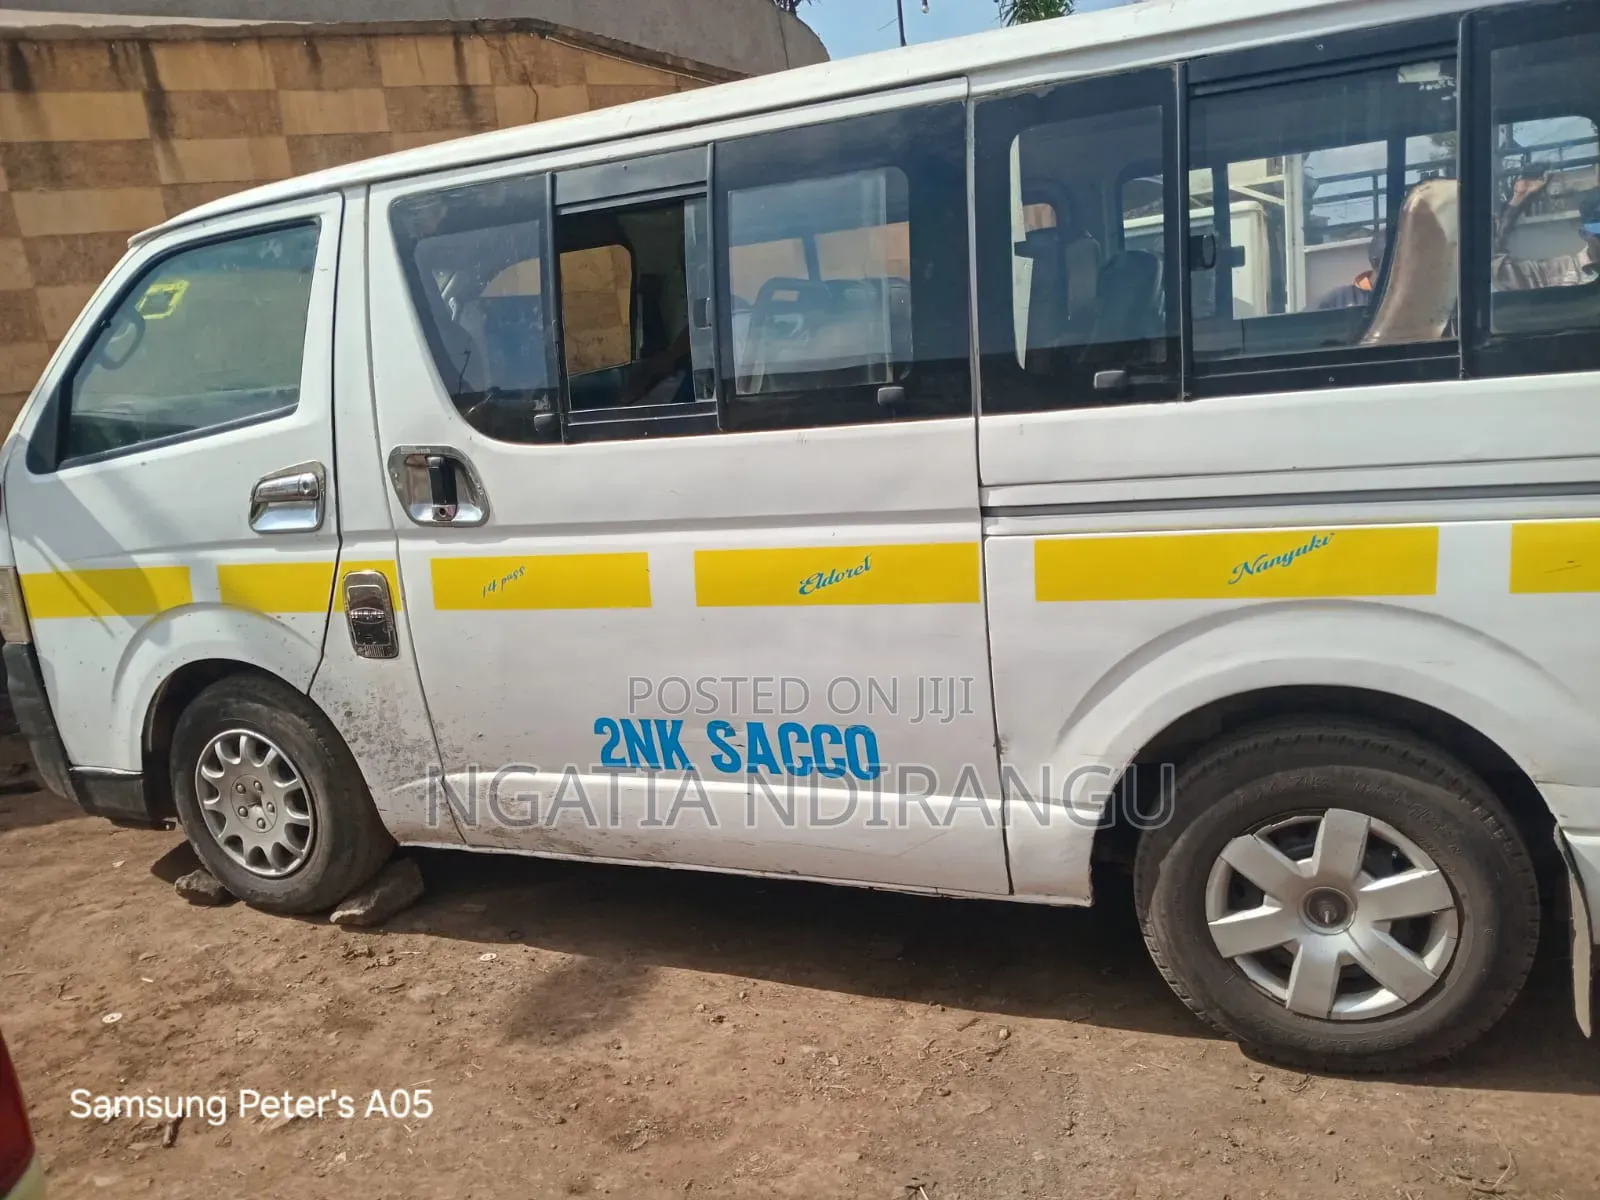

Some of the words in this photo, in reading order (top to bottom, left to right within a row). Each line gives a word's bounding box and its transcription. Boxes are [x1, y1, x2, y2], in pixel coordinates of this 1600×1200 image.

[799, 552, 873, 595] Eldoret
[1227, 531, 1336, 585] Nanyuki
[593, 717, 694, 770] 2NK
[706, 719, 881, 781] SACCO
